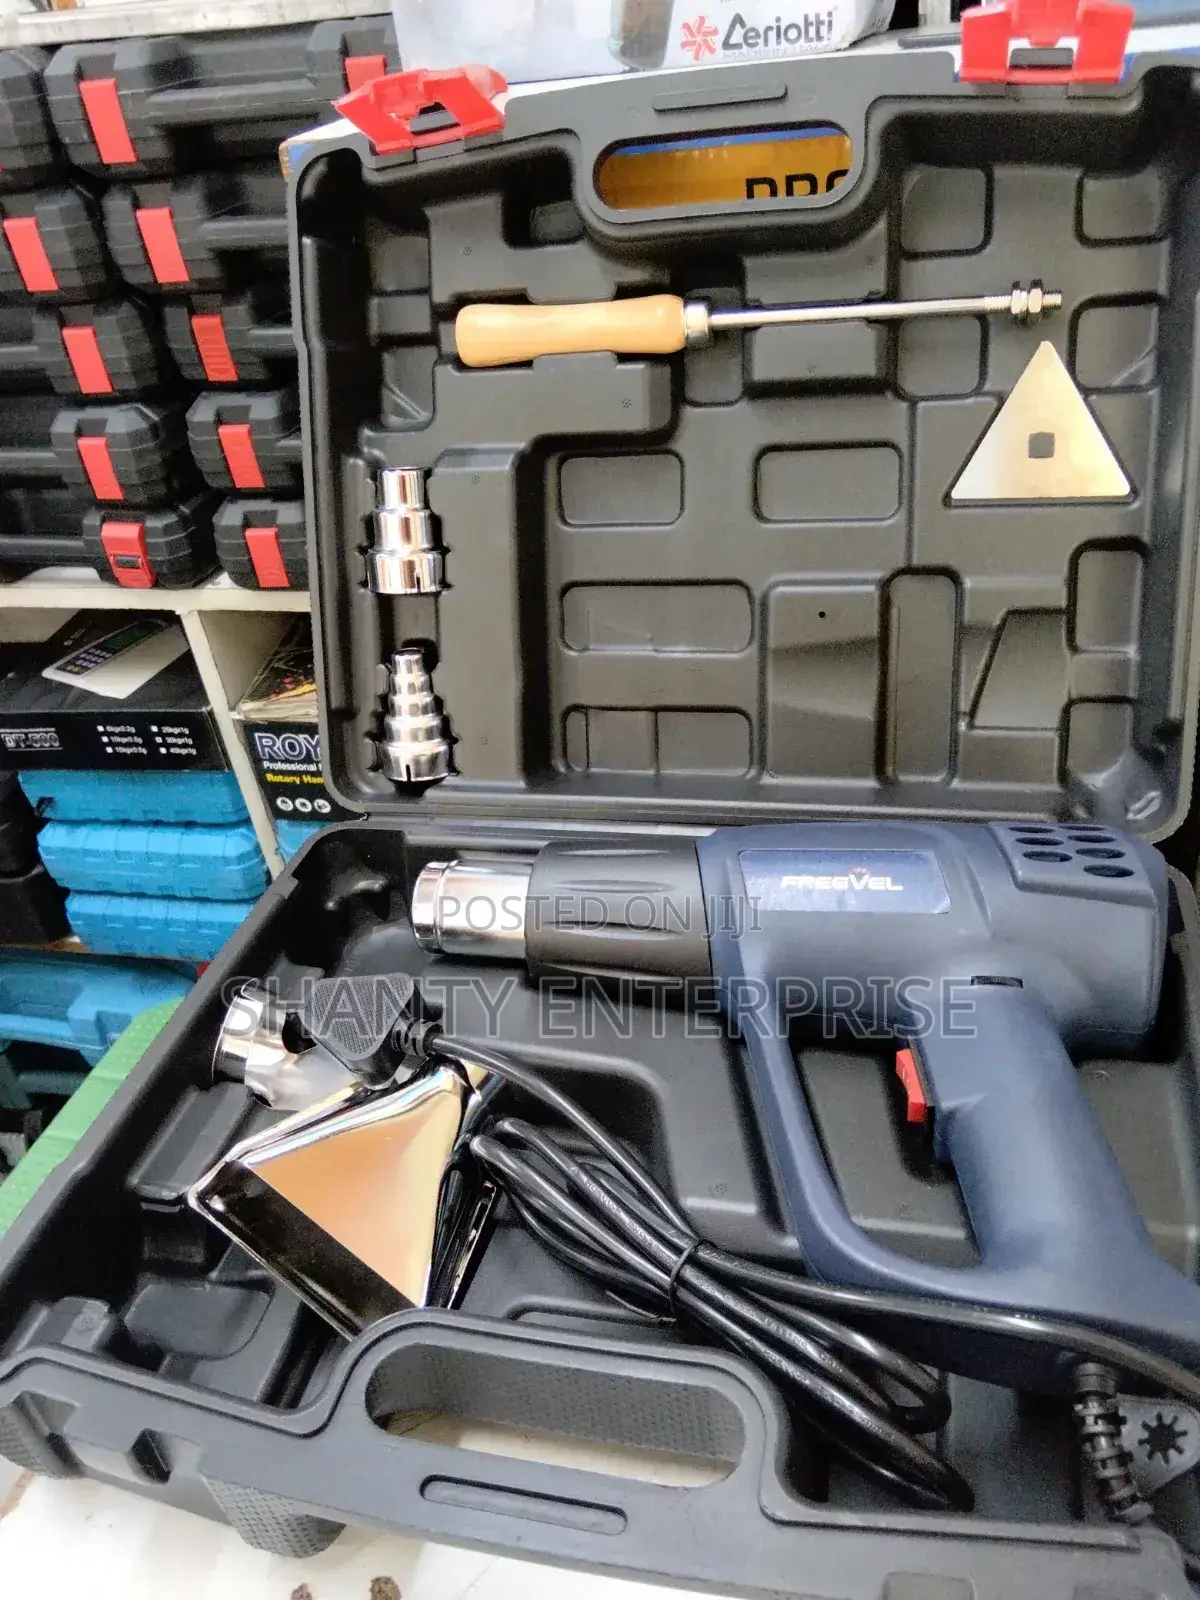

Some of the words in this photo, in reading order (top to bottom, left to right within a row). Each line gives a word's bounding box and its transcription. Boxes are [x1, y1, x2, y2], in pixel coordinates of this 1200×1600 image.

[262, 761, 317, 771] Professional
[265, 773, 300, 785] Rotary
[780, 874, 904, 891] FREEVEL
